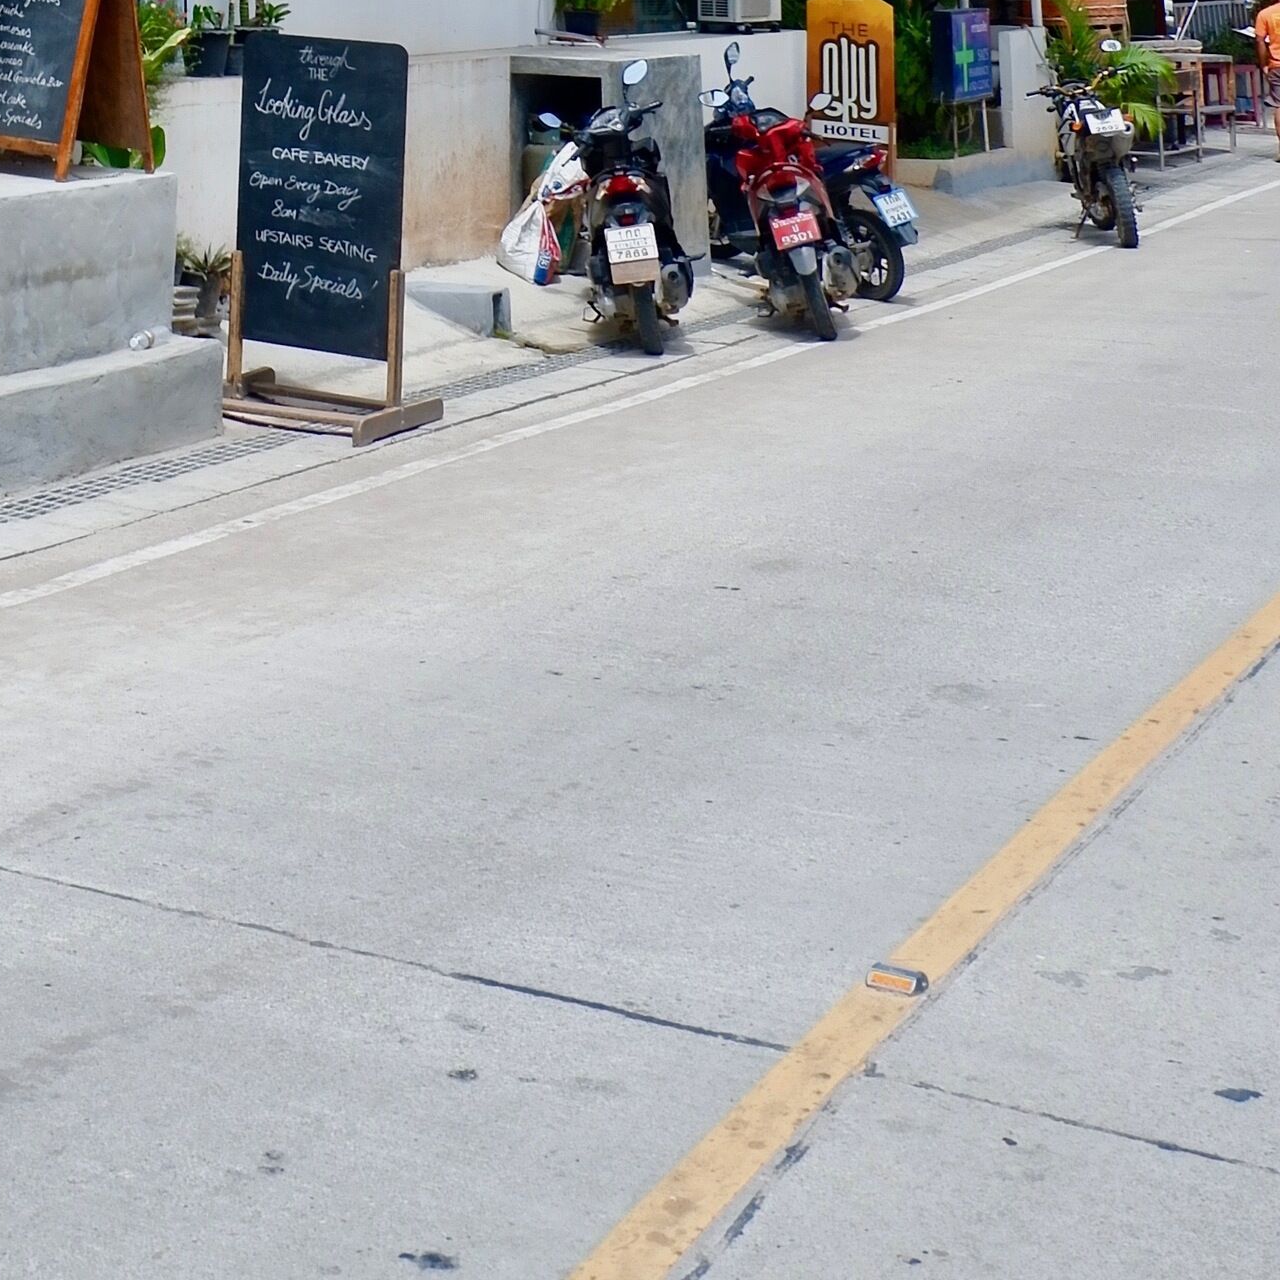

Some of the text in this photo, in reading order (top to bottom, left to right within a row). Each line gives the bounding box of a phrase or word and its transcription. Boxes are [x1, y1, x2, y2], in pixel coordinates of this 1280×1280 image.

[828, 21, 869, 37] THE
[299, 46, 357, 78] through
[308, 67, 329, 82] THE
[254, 77, 372, 141] Looking Glass
[823, 124, 882, 140] HOTEL
[249, 171, 363, 211] Open Every Day
[255, 229, 378, 263] UPSTAIRS SEATING
[257, 261, 301, 300] Daily
